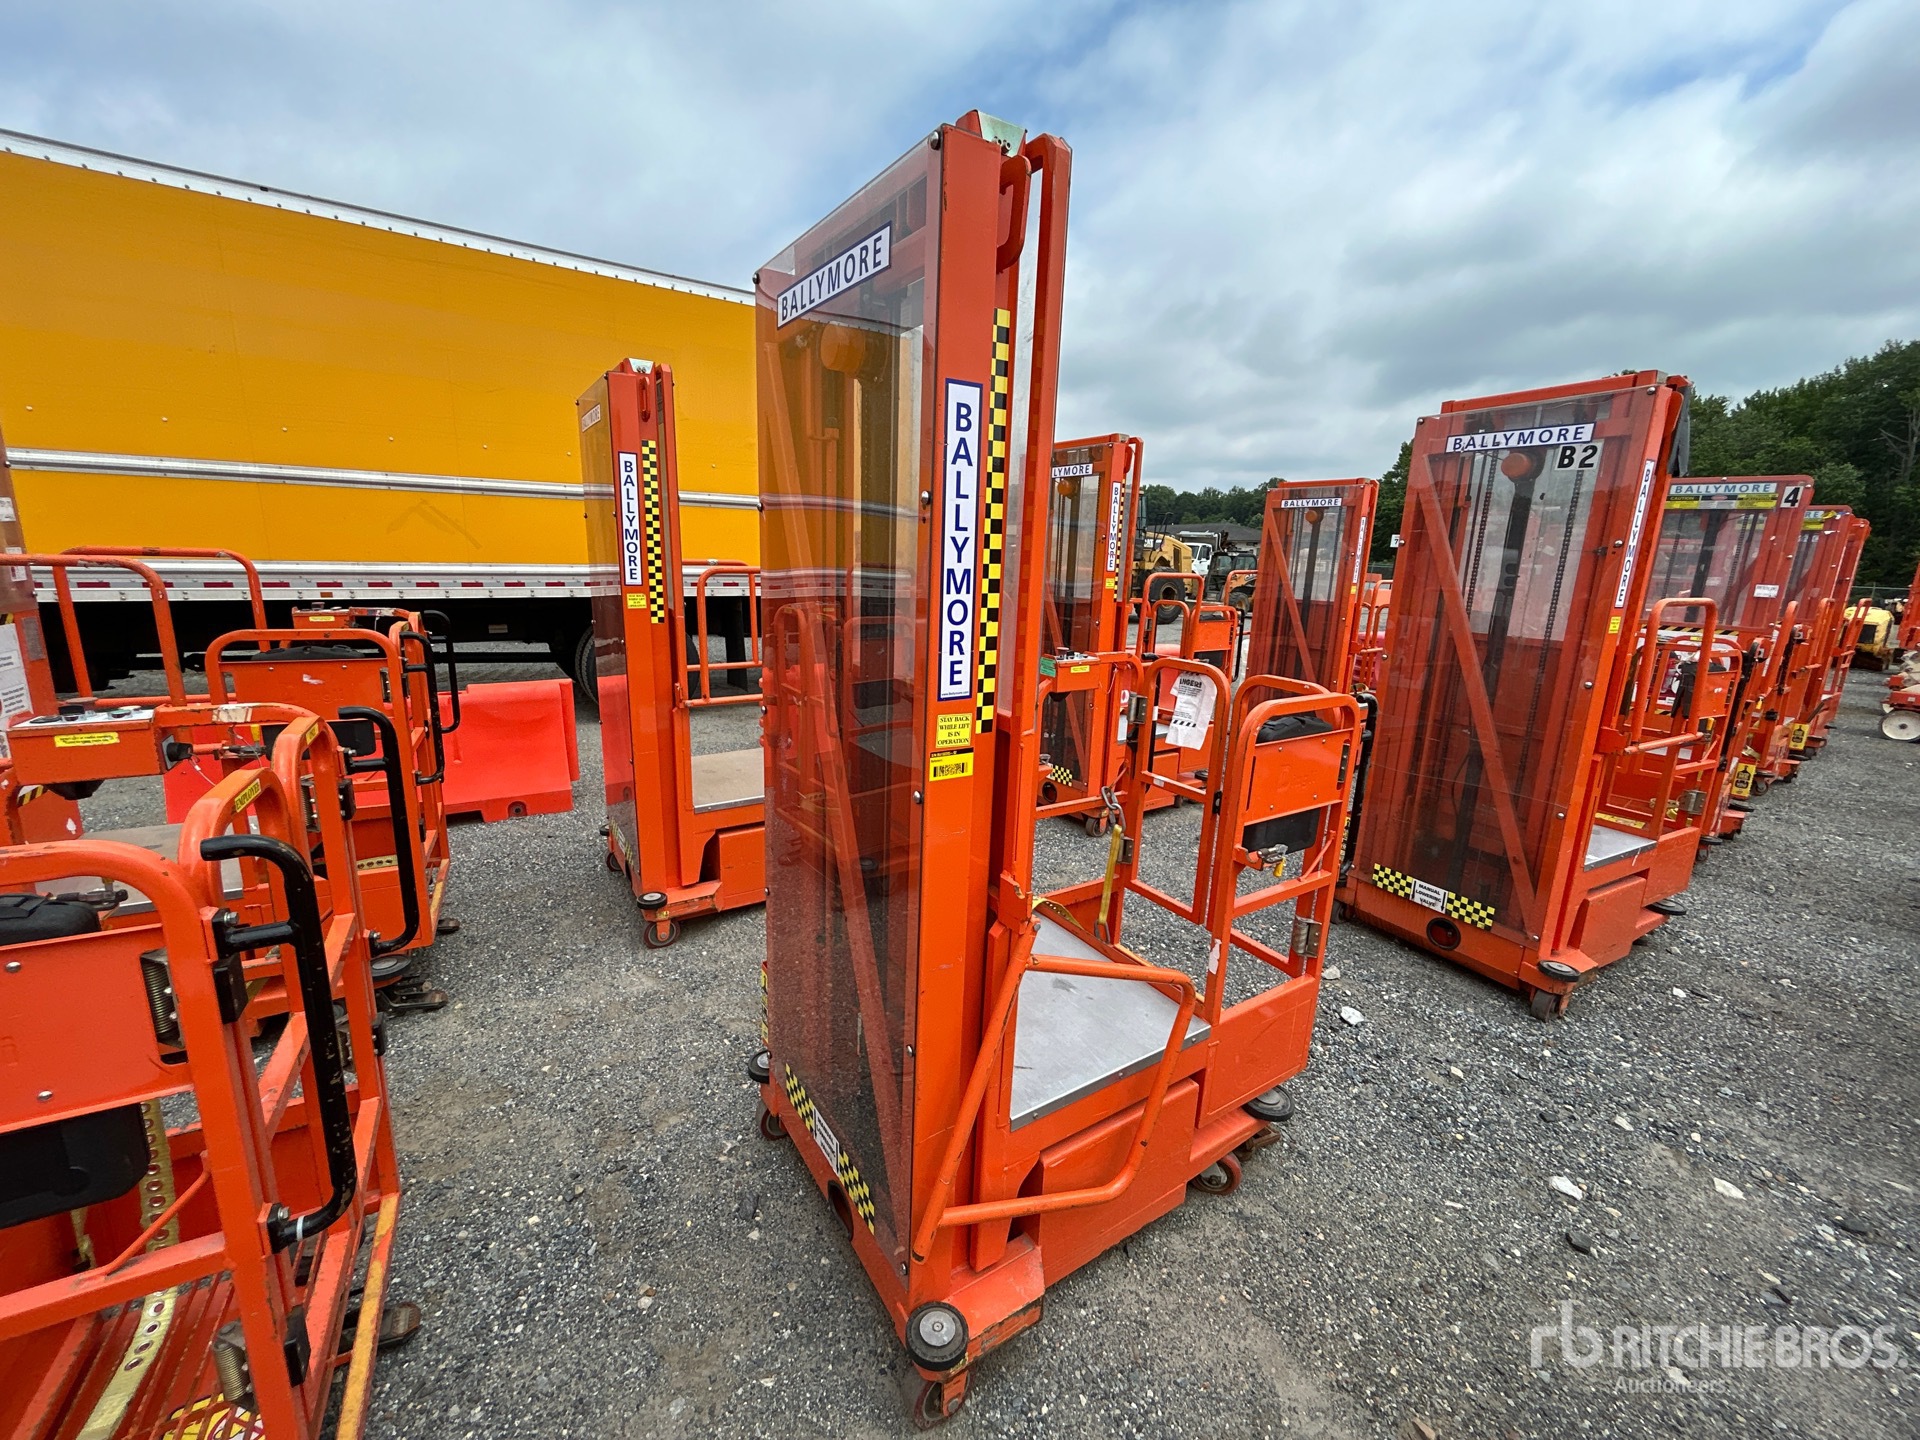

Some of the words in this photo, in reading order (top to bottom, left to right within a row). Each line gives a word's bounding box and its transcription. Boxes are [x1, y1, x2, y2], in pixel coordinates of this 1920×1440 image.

[781, 235, 882, 321] BALLYMORE
[1453, 426, 1585, 450] BALLYMORE
[1675, 484, 1772, 493] BALLYMORE
[1784, 487, 1801, 507] 4
[1284, 499, 1340, 507] BALLYMORE
[623, 460, 639, 580] BALLYMORE
[1109, 487, 1119, 568] BALLYMORE
[946, 402, 973, 686] BALLYMORE
[1618, 468, 1651, 602] BALLYMORE
[1415, 889, 1442, 903] LOWERING
[1419, 883, 1441, 896] MANUAL
[1420, 898, 1436, 907] VALVE
